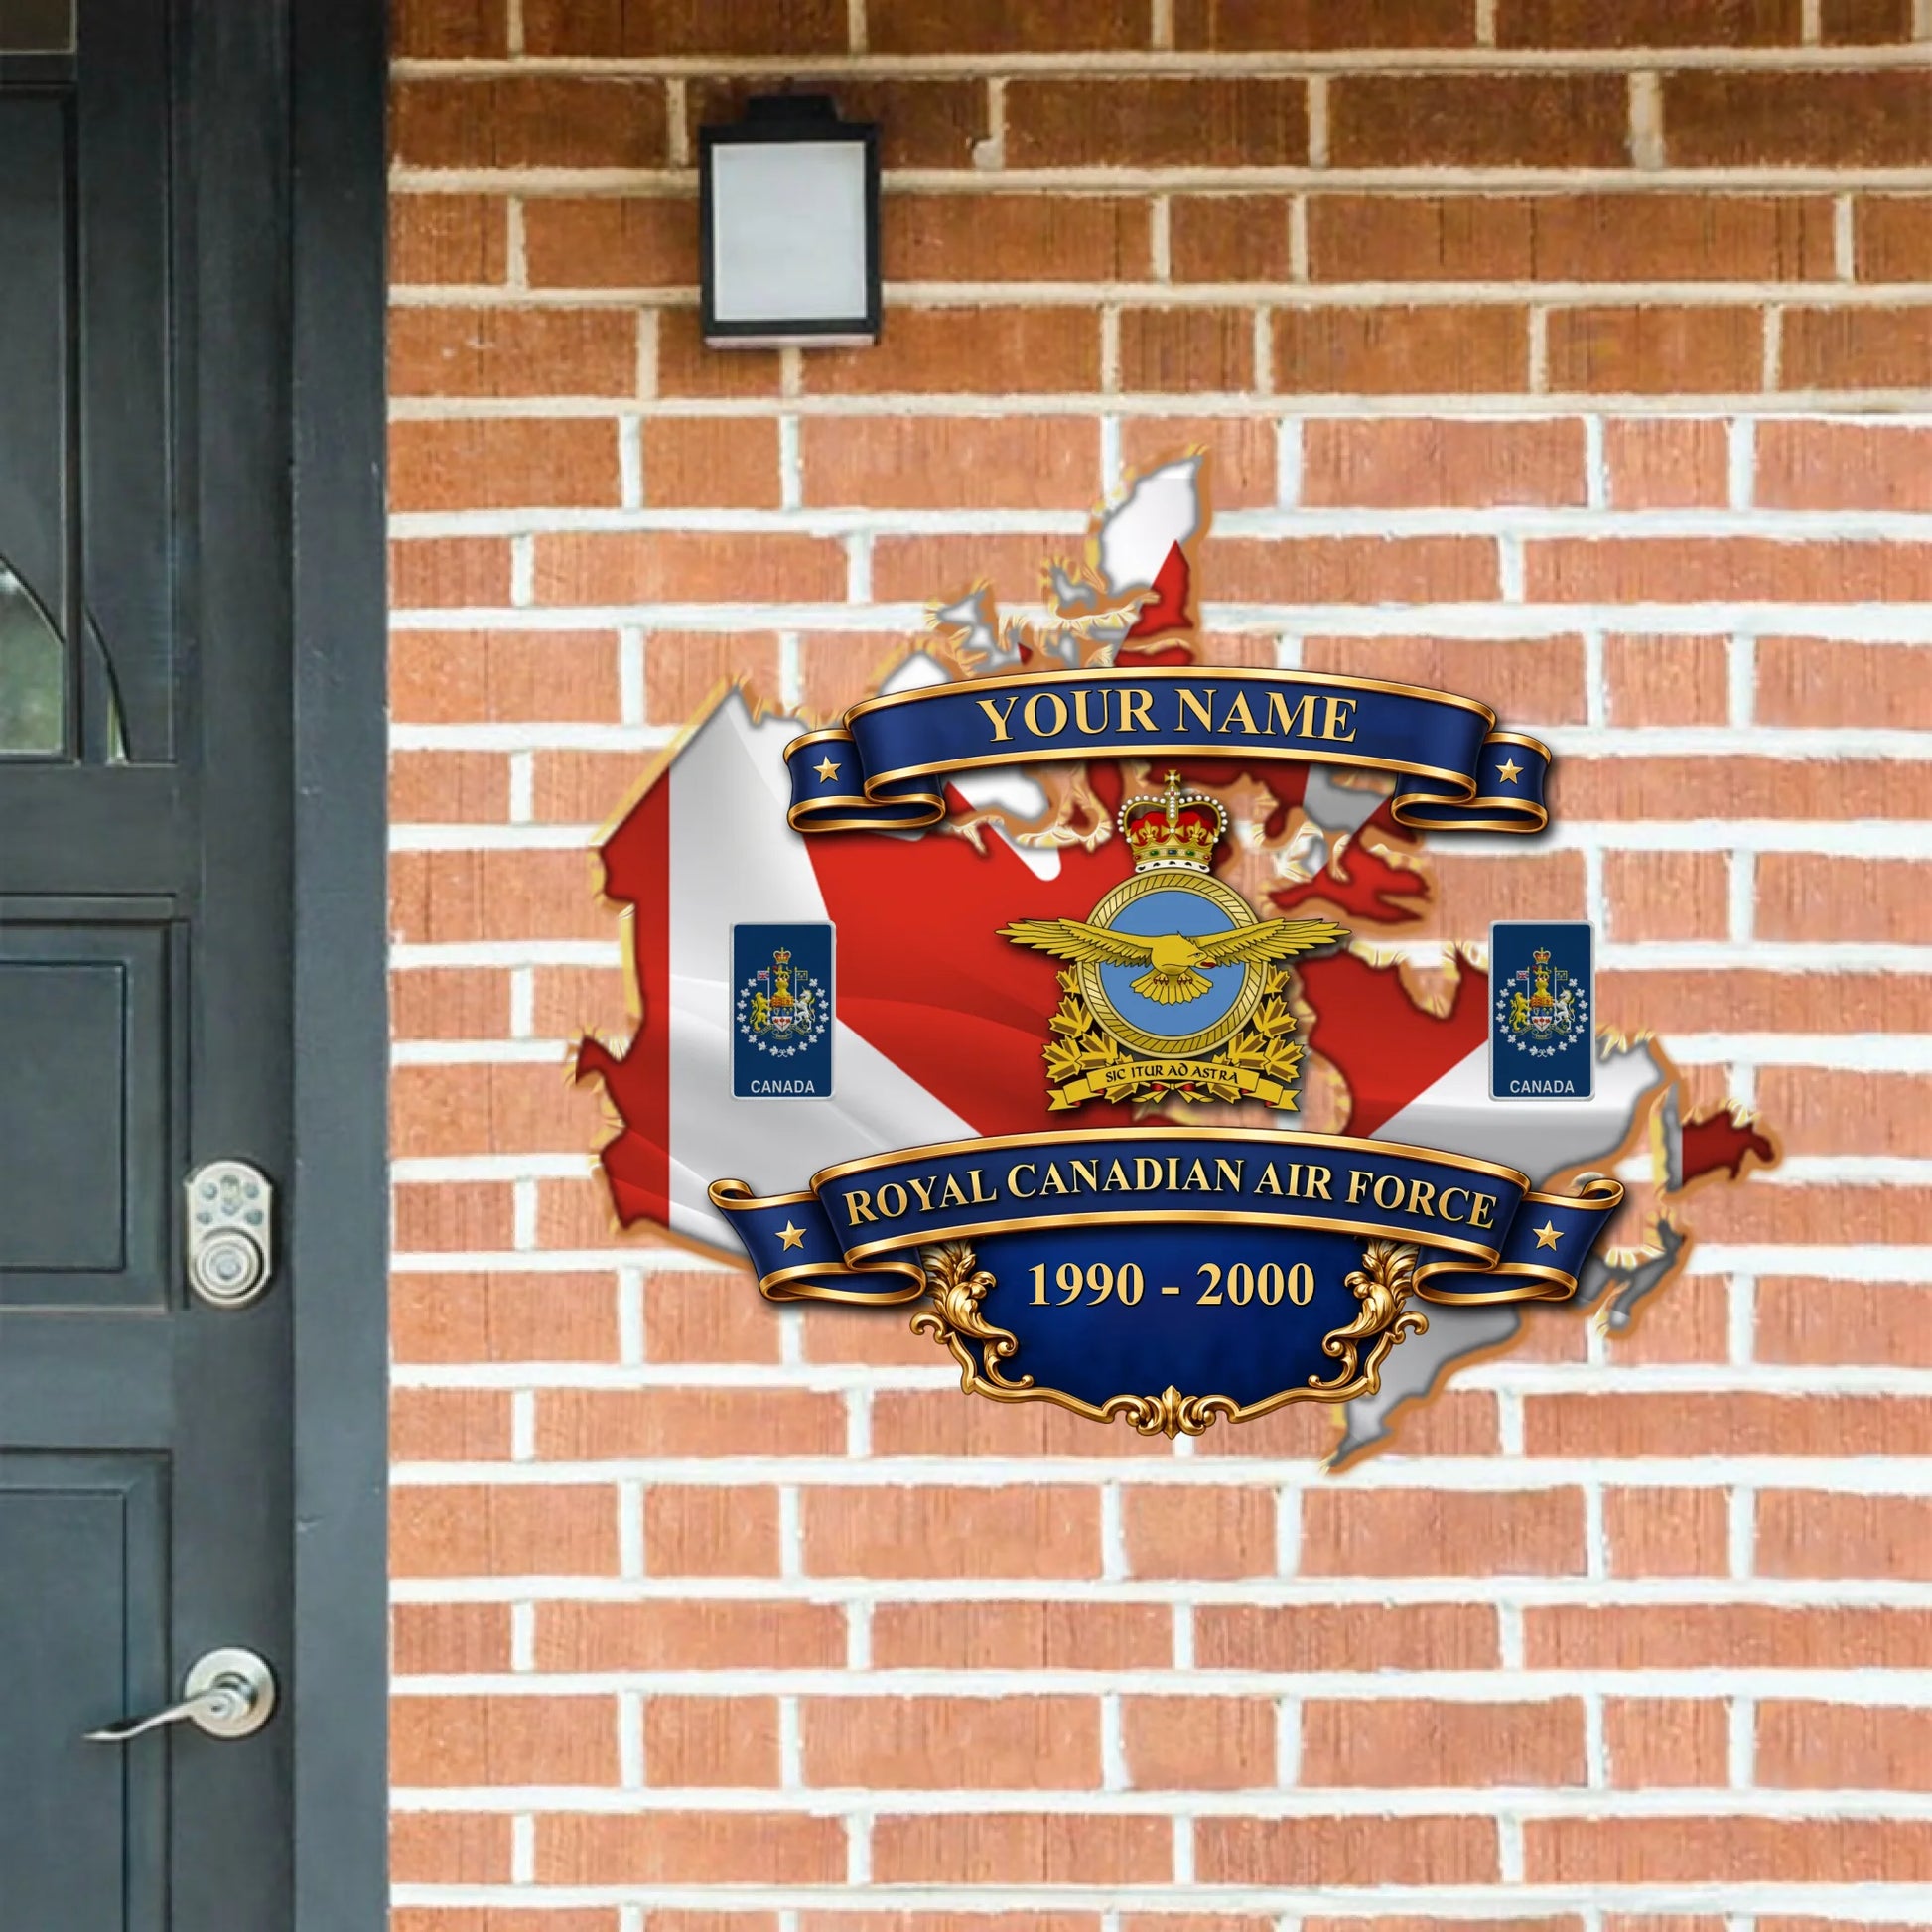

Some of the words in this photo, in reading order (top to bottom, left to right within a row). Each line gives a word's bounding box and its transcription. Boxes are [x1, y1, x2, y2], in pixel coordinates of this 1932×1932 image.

[976, 688, 1160, 742] YOUR
[1173, 688, 1357, 743] NAME
[750, 1079, 815, 1094] CANADA
[1105, 1068, 1125, 1082] SIC
[1131, 1064, 1163, 1077] ITUR
[1166, 1062, 1188, 1075] AD
[1191, 1066, 1238, 1083] ASTRA
[1509, 1079, 1575, 1094] CANADA
[842, 1169, 998, 1227] ROYAL
[1006, 1157, 1244, 1200] CANADIAN
[1253, 1161, 1333, 1202] AIR
[1344, 1169, 1498, 1231] FORCE
[1027, 1262, 1145, 1308] 1990
[1195, 1262, 1316, 1308] 2000
